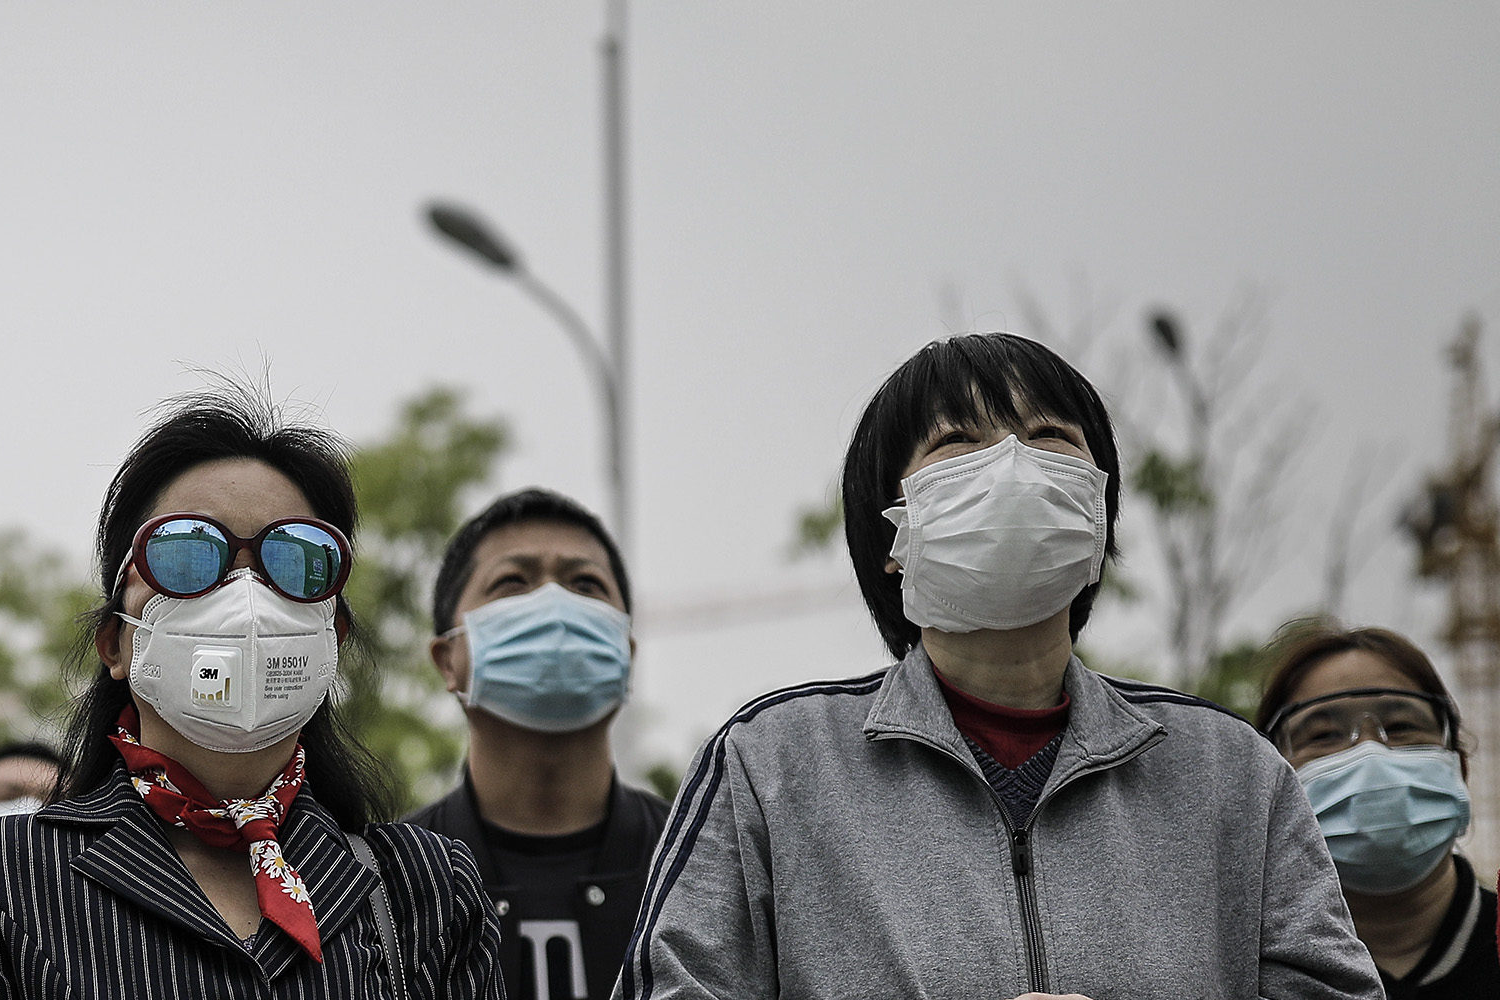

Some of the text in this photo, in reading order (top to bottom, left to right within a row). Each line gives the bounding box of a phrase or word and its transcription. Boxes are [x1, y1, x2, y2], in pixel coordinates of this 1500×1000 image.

[266, 655, 309, 669] 3M 9501V
[199, 668, 218, 680] 3M
